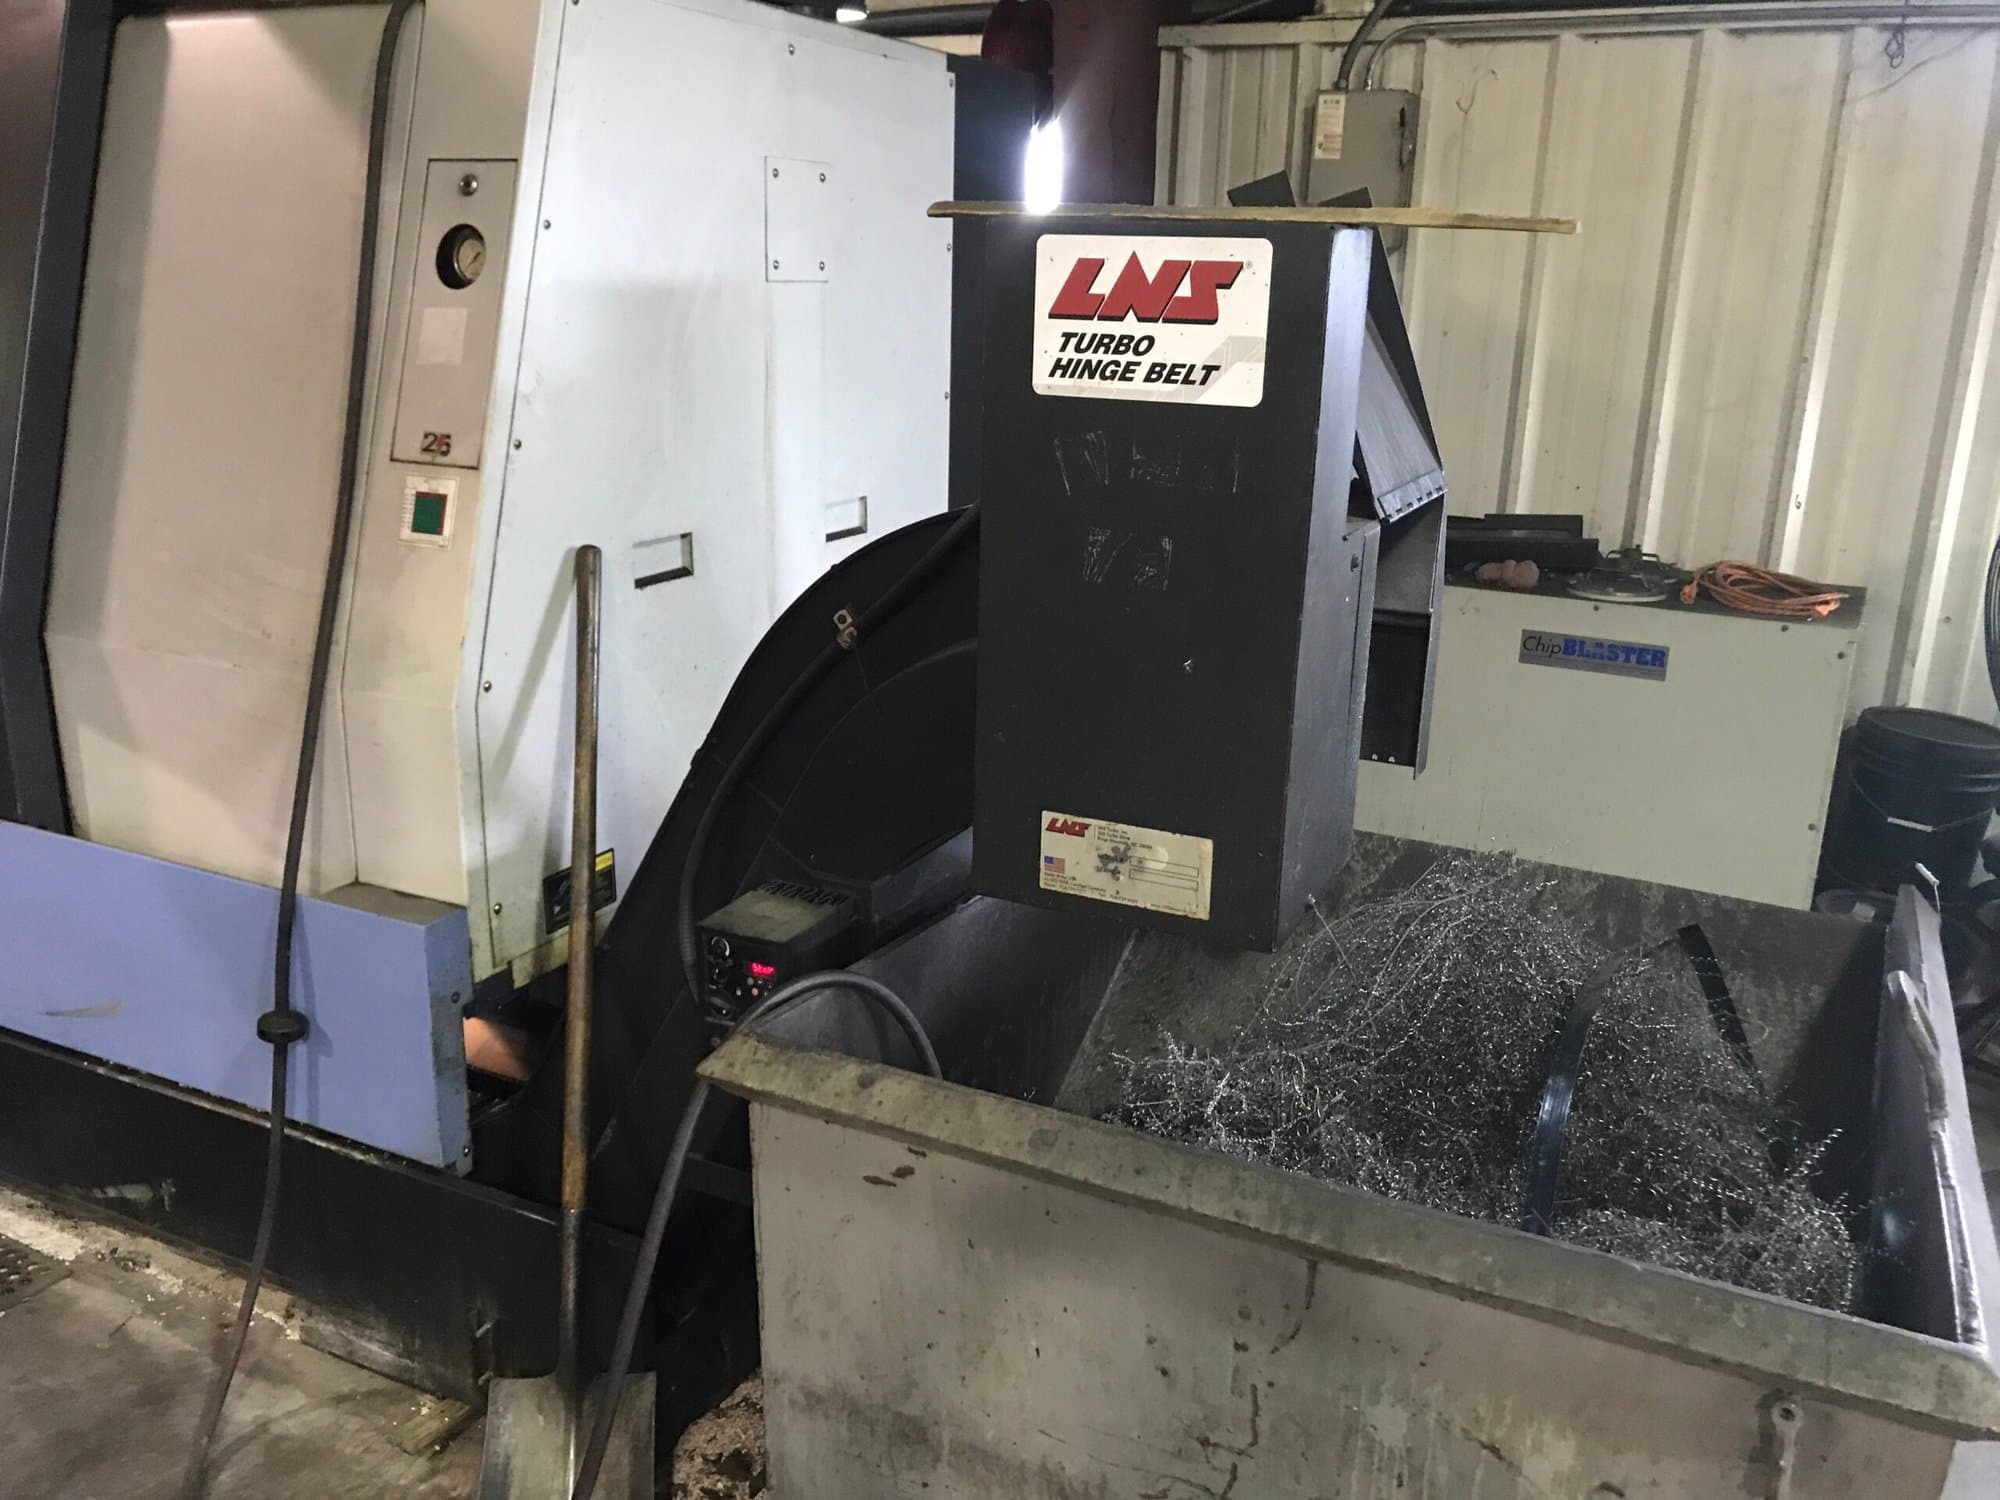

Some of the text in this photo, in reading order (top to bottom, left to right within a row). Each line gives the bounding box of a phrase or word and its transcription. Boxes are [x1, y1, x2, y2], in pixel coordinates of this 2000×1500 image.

[1048, 250, 1243, 325] LNS
[1058, 332, 1155, 356] TURBO
[1048, 357, 1221, 386] HINGE BELT
[1046, 818, 1091, 837] LNS
